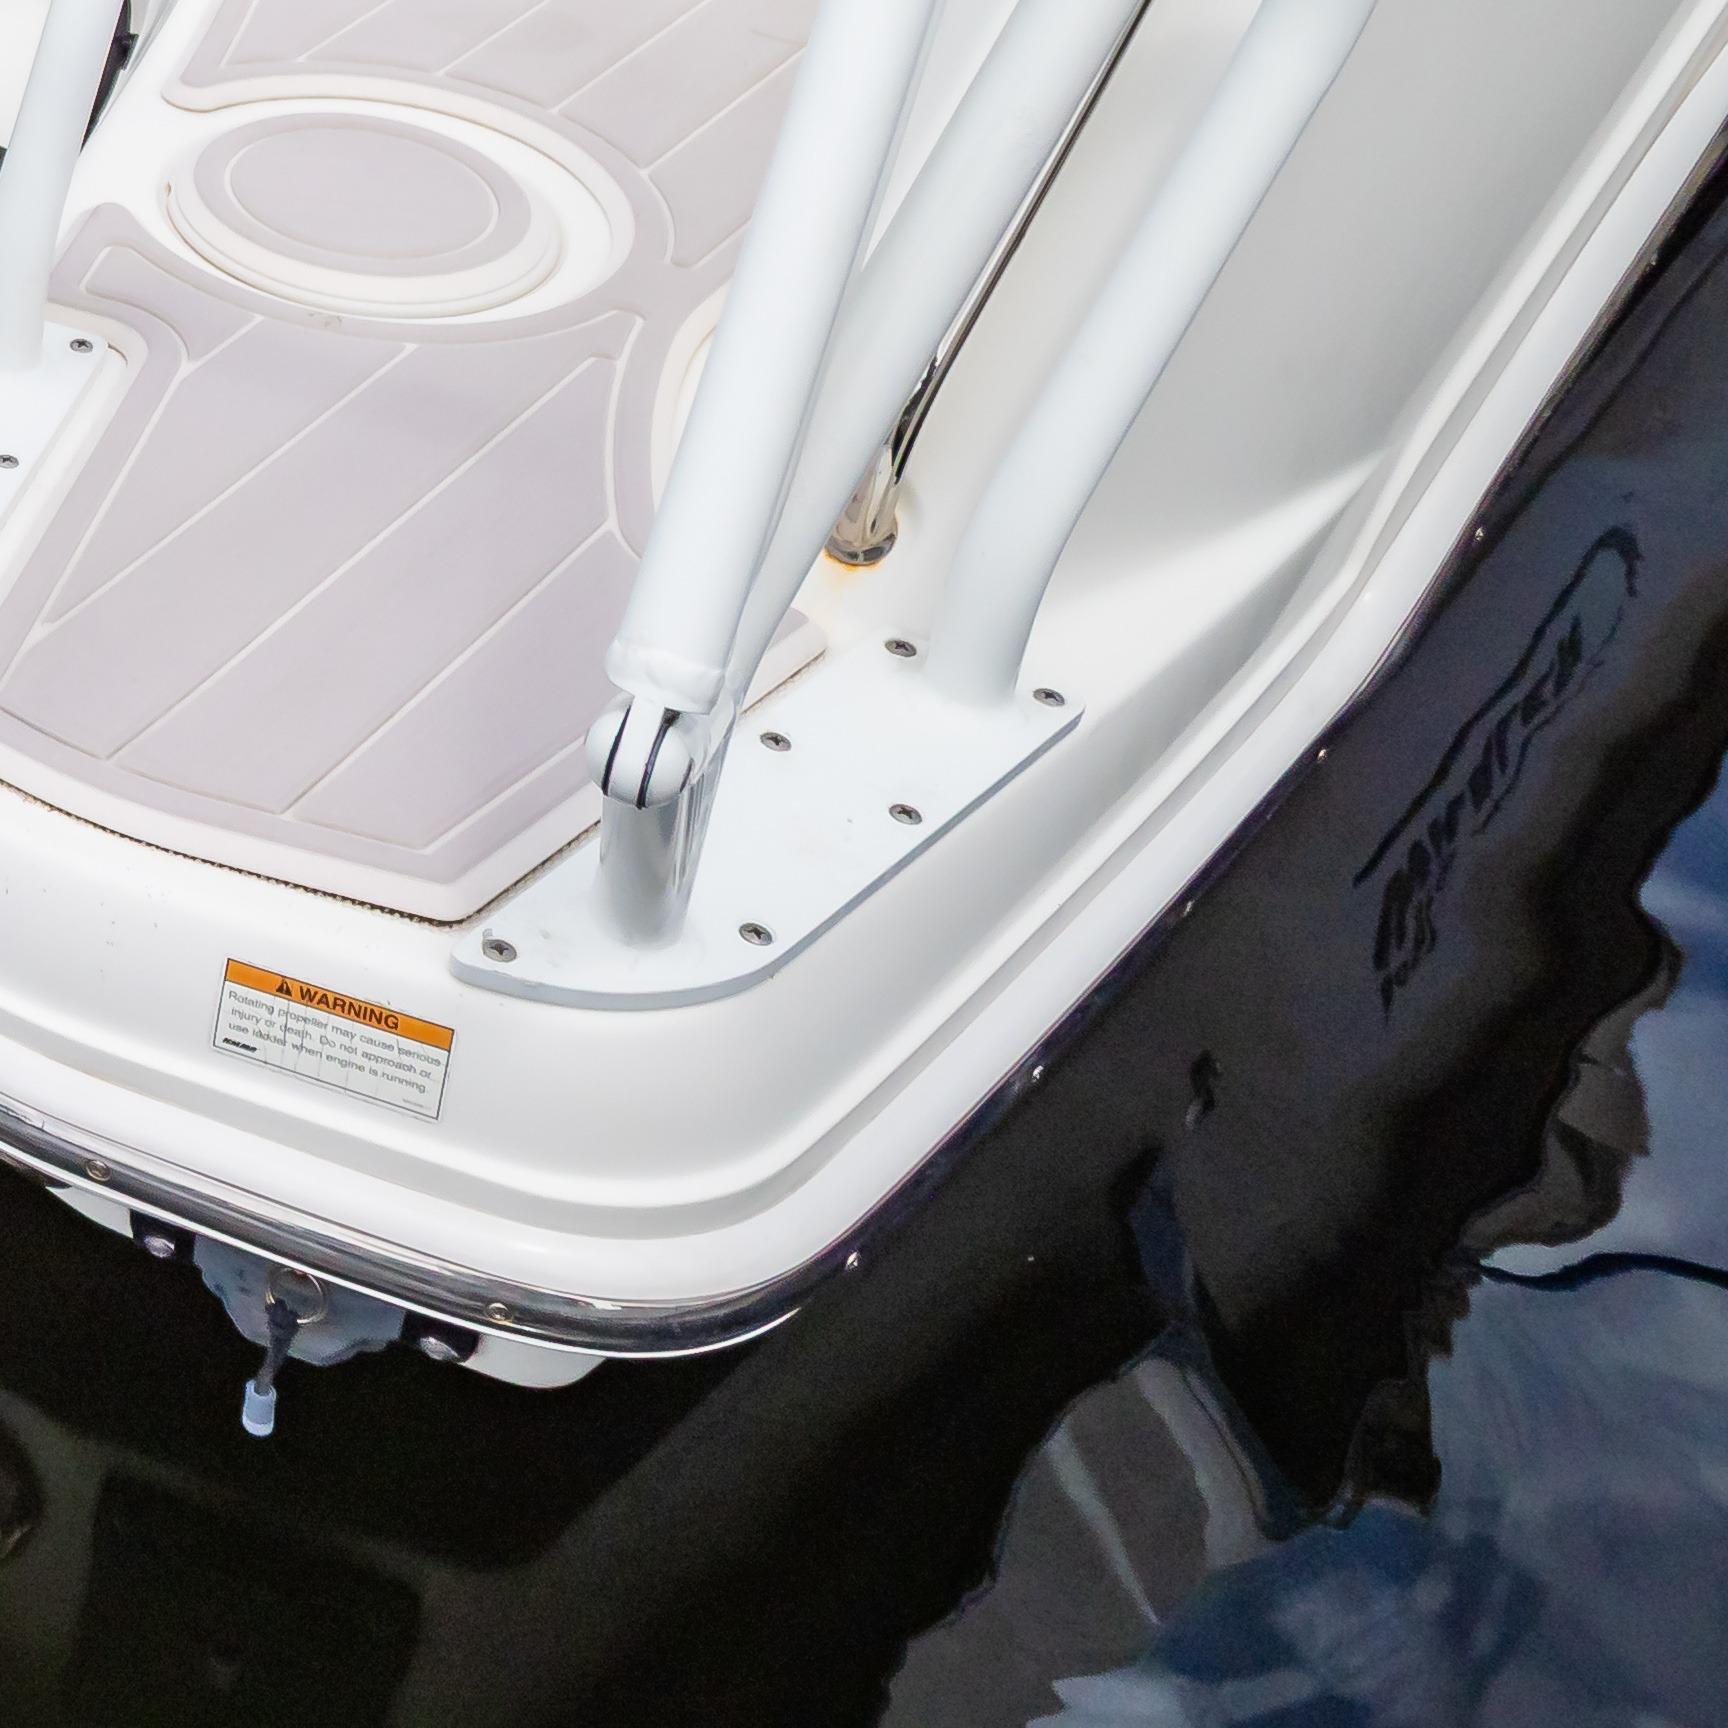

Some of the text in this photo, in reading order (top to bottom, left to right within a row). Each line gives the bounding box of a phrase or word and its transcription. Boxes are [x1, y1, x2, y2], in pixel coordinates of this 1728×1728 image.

[228, 990, 442, 1067] Rotating propeller may cause serious
[299, 985, 400, 1030] WARNING
[228, 1023, 250, 1036] use
[252, 1028, 287, 1047] ladder
[291, 1041, 323, 1059] when
[325, 1052, 366, 1073] engine
[368, 1065, 379, 1077] is
[231, 1007, 262, 1027] injury
[264, 1019, 278, 1028] or
[319, 1034, 336, 1049] Do
[339, 1040, 358, 1055] not
[361, 1050, 417, 1075] approach
